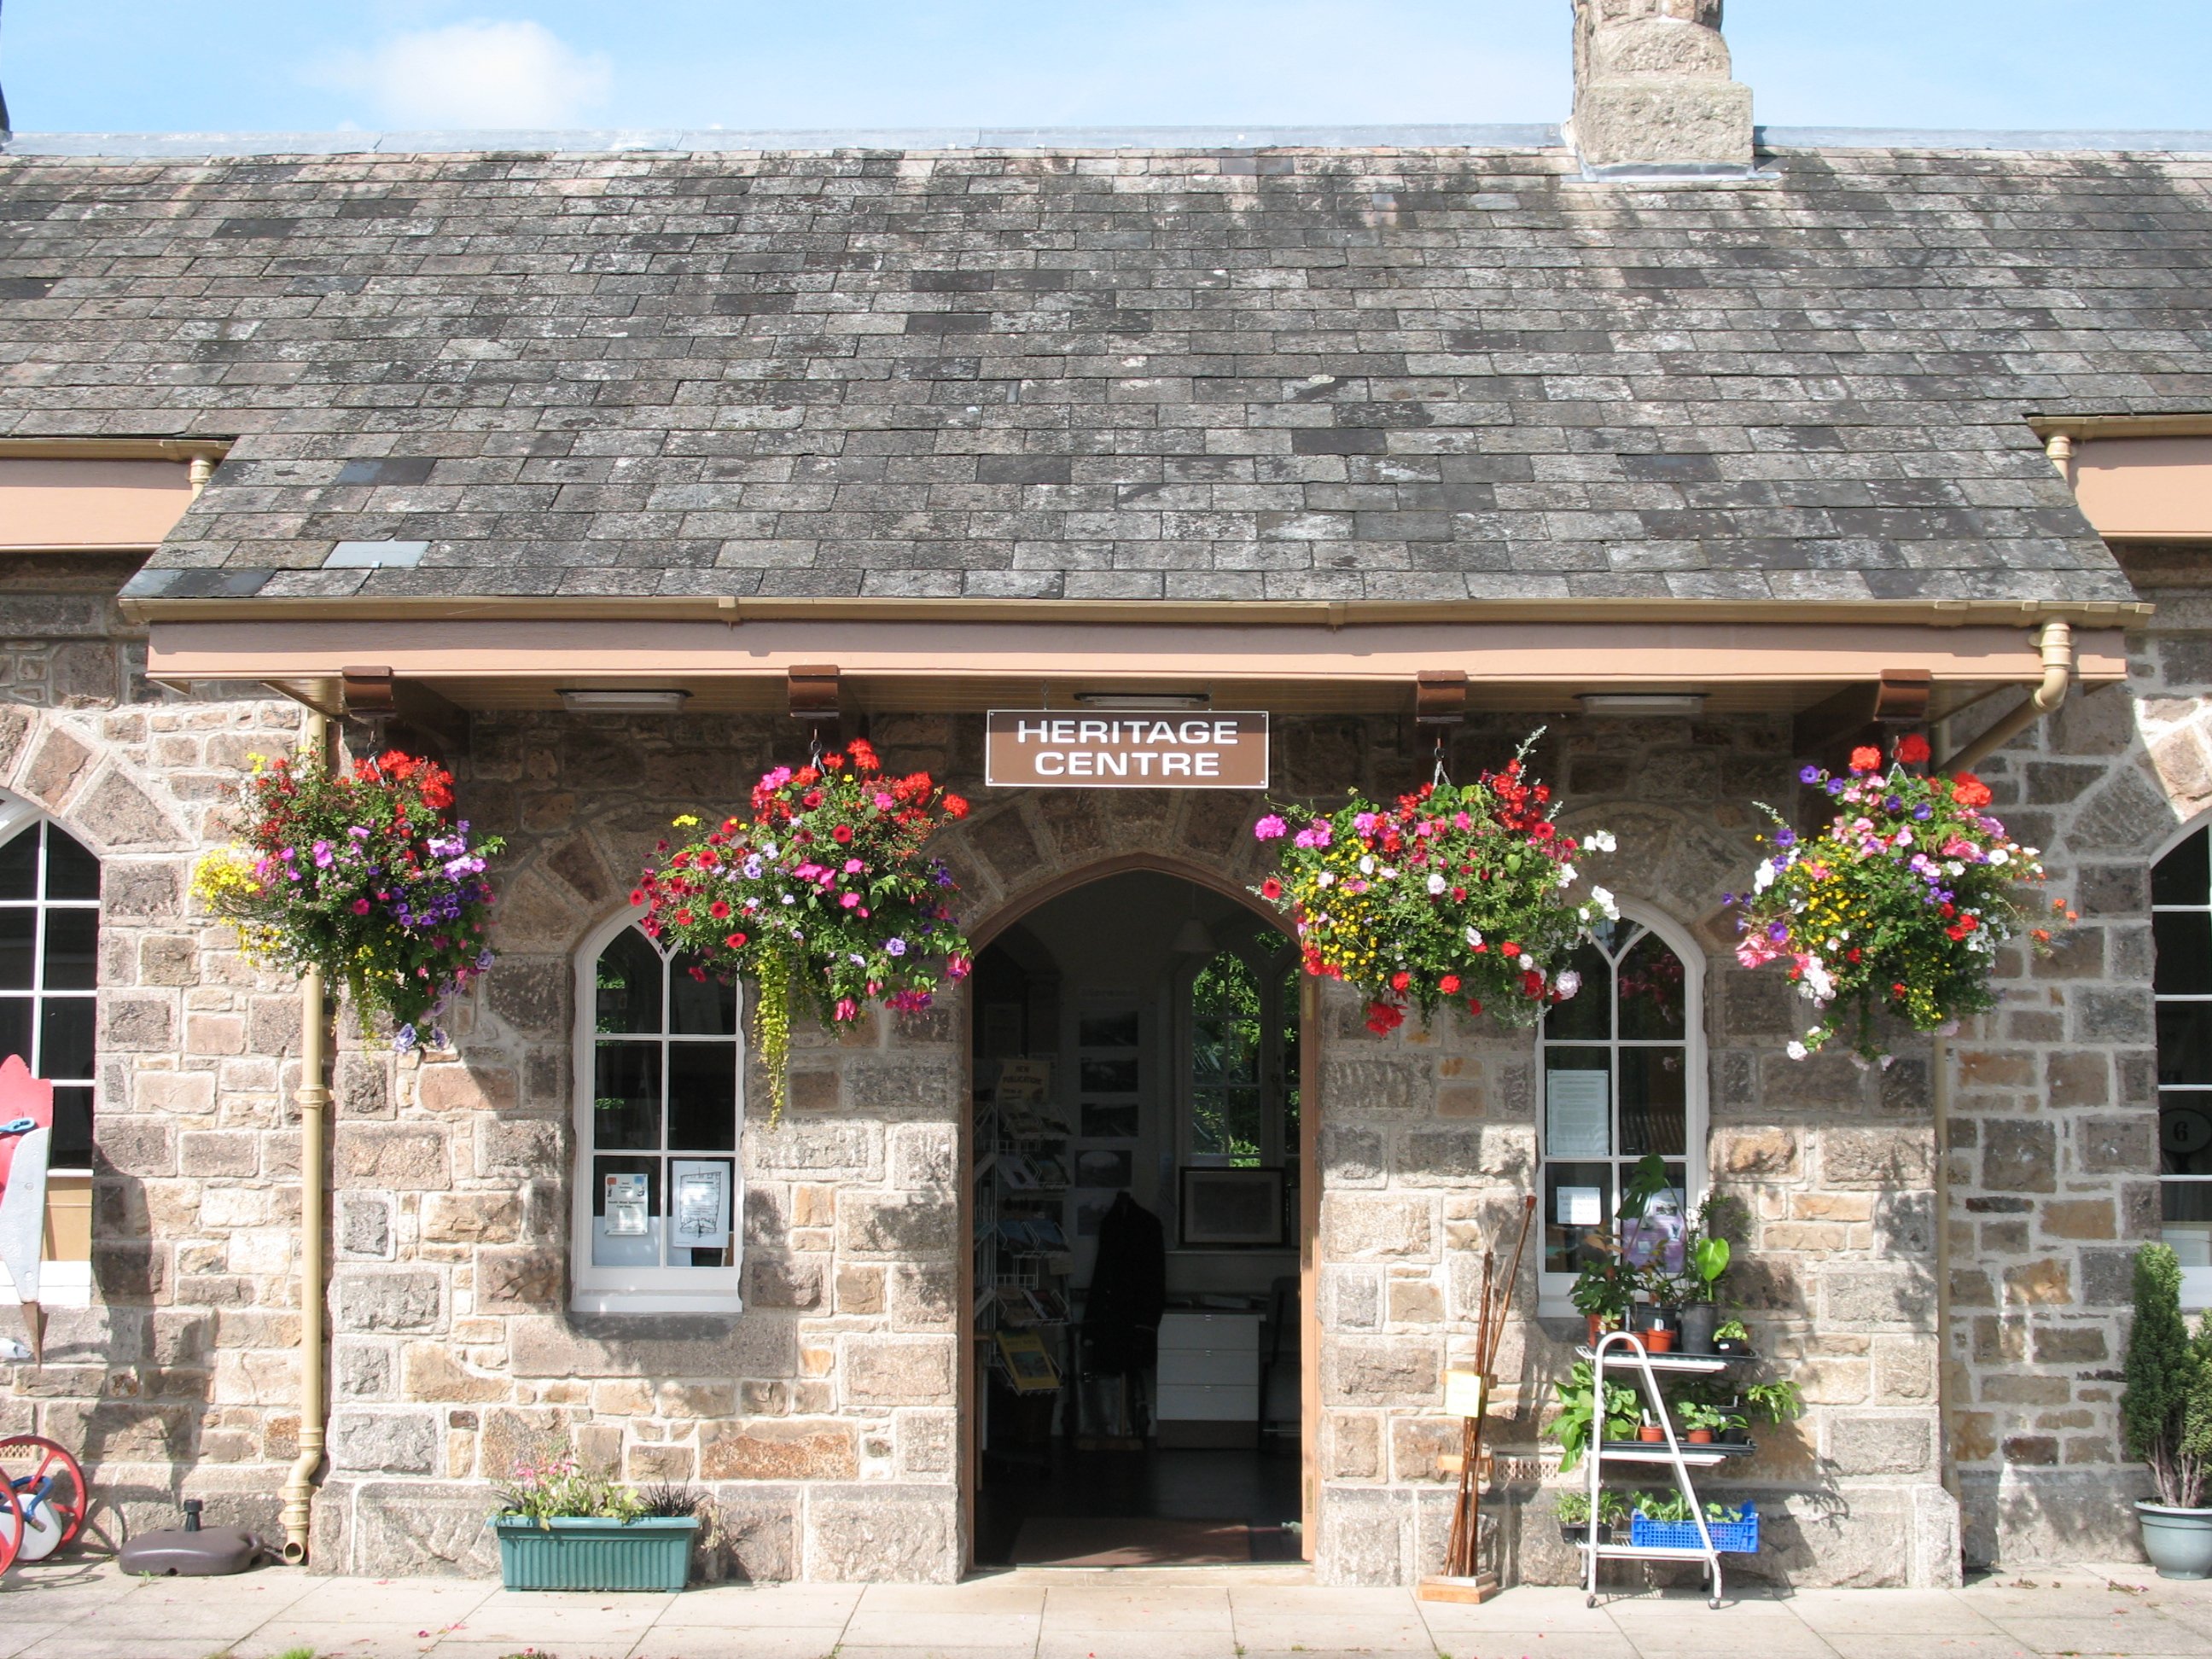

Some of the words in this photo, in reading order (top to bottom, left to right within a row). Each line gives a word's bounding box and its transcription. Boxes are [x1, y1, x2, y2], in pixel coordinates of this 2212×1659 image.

[1017, 719, 1238, 745] HERITAGE
[1034, 751, 1220, 777] CENTRE
[2173, 1121, 2189, 1142] 6
